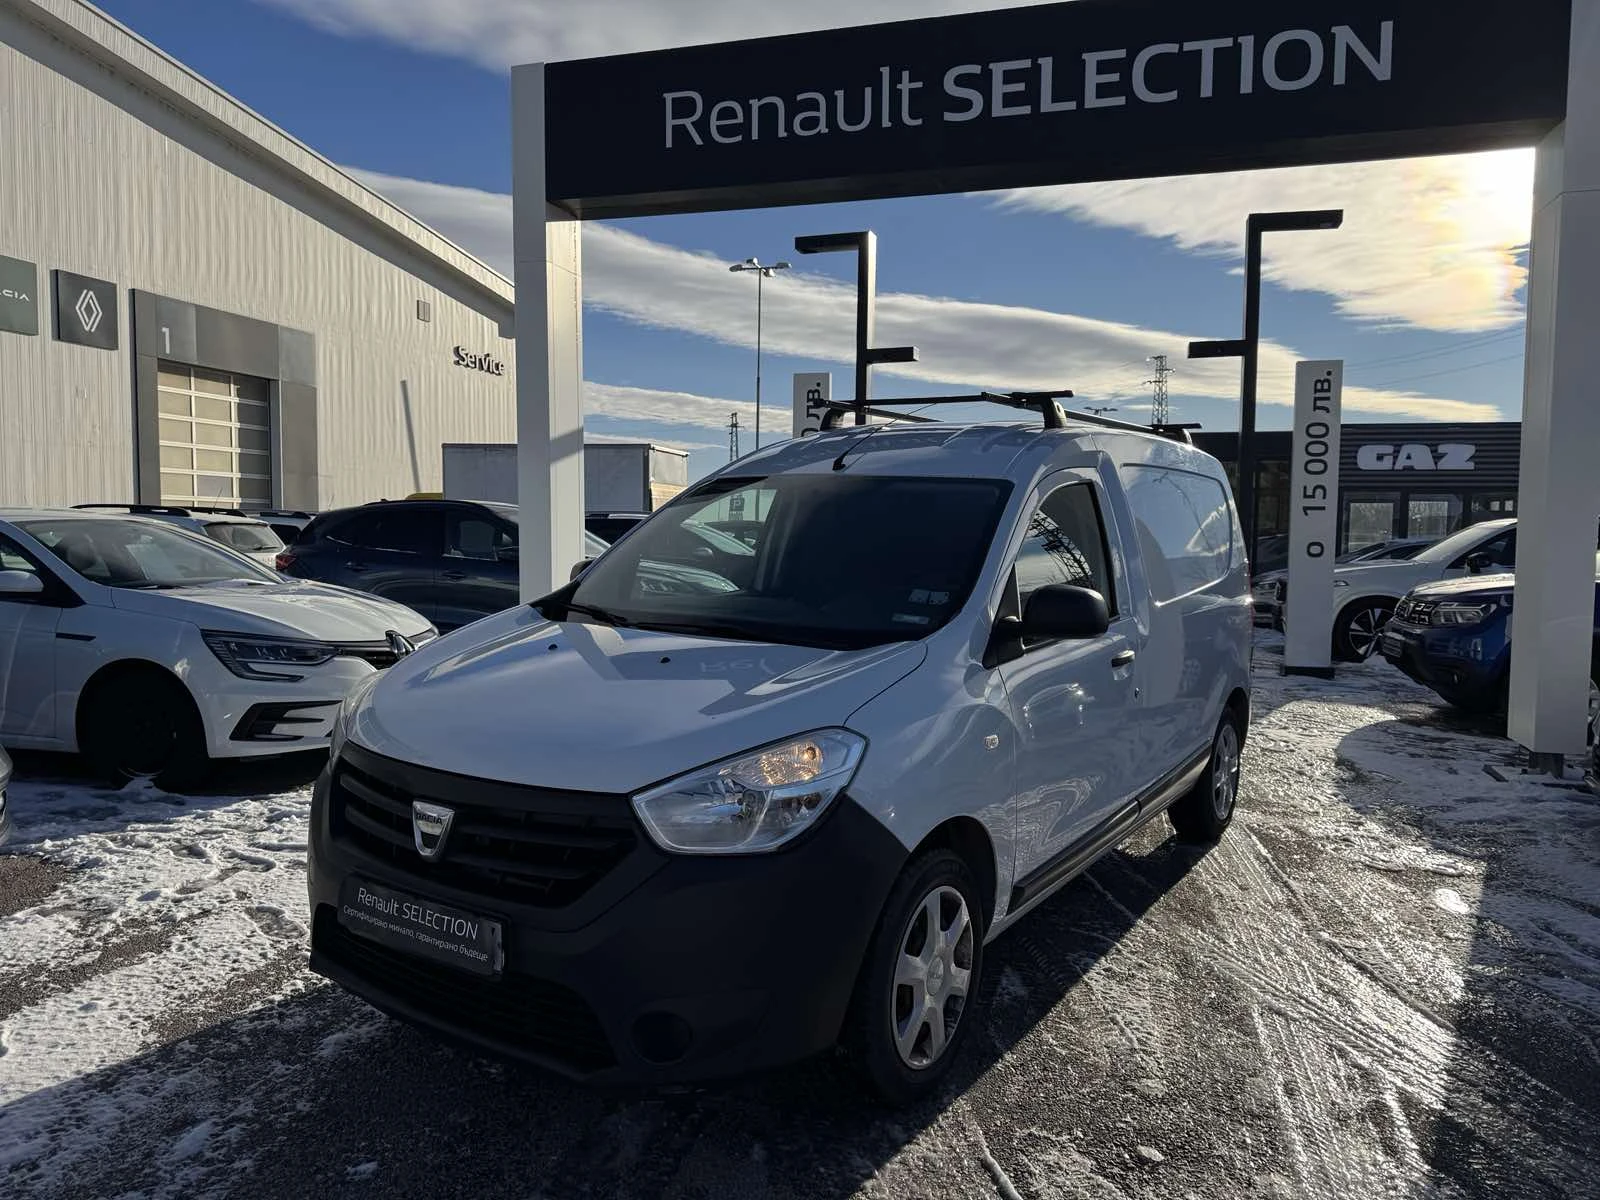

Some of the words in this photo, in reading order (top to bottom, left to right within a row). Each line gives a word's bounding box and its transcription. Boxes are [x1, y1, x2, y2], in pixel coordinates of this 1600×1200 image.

[662, 66, 923, 148] Renault
[942, 20, 1395, 122] SELECTION
[0, 288, 30, 302] CIA
[161, 326, 171, 354] 1
[453, 346, 505, 376] Service
[1304, 422, 1330, 475] 000
[1357, 443, 1476, 470] GAZ
[1302, 484, 1327, 516] 15
[416, 812, 443, 826] DACIA
[343, 904, 388, 929] Сертифицирано
[415, 931, 458, 952] гарантирано
[357, 887, 399, 916] Renault
[402, 903, 478, 940] SELECTION
